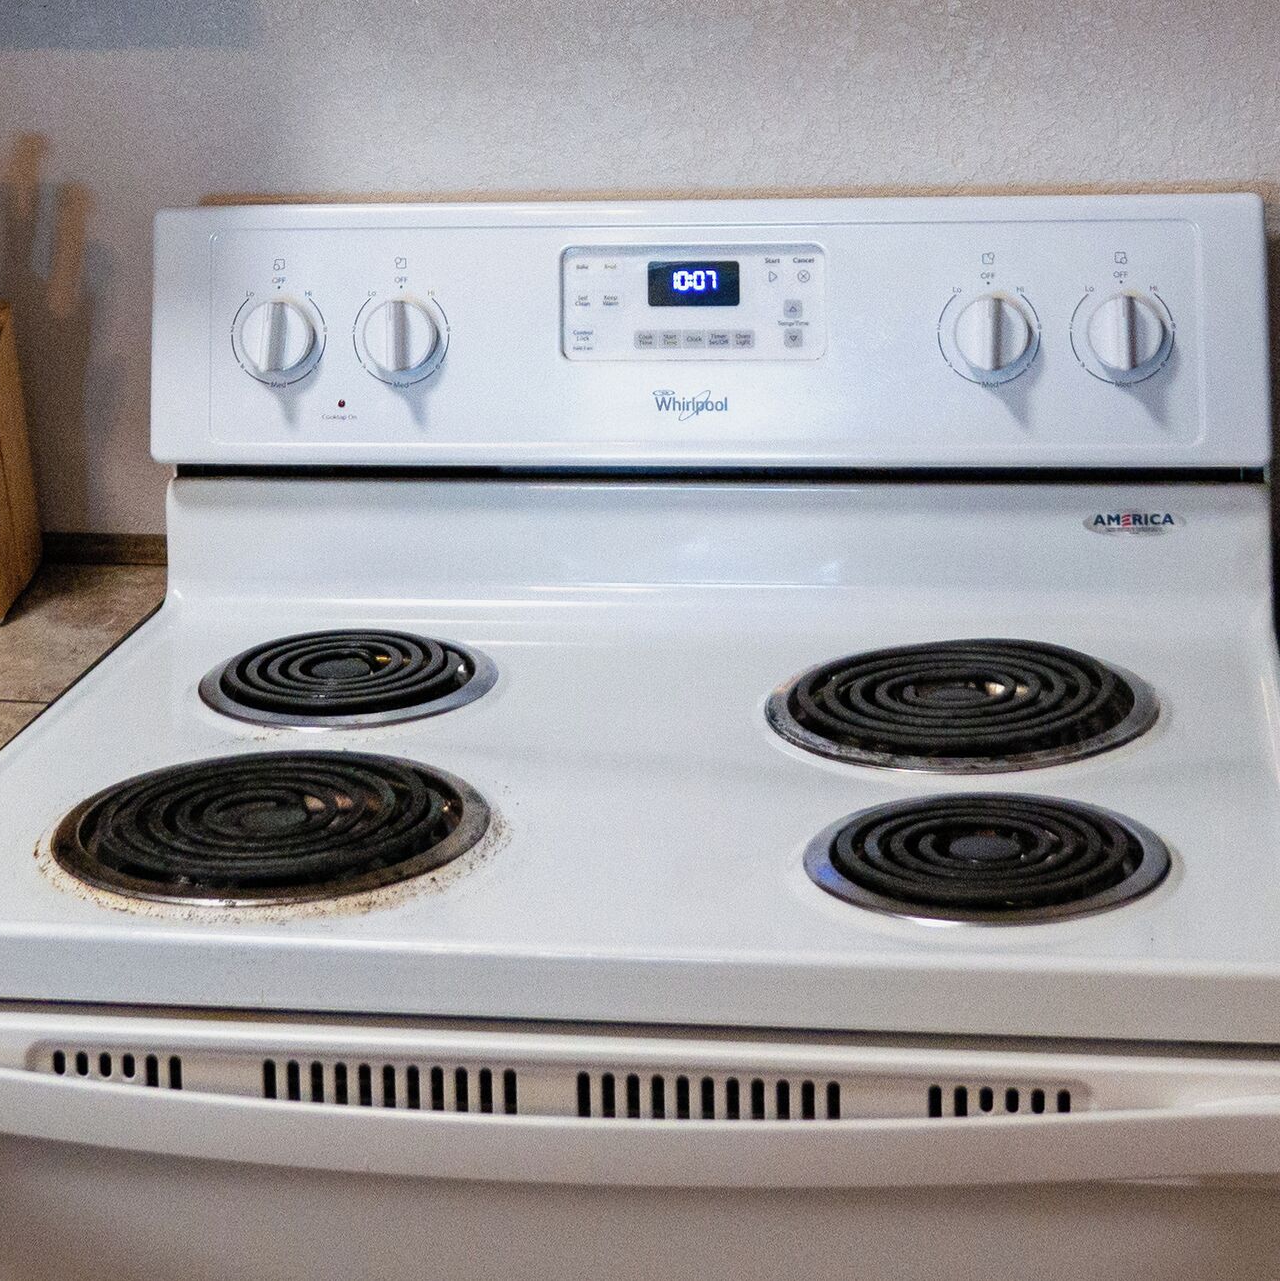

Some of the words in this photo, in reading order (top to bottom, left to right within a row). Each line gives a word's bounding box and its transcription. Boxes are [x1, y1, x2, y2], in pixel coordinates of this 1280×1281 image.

[980, 272, 995, 280] OFF
[1113, 271, 1128, 279] OFF
[394, 276, 408, 284] OFF
[672, 270, 718, 291] 10:07
[270, 381, 287, 389] Med
[393, 381, 410, 389] Med
[981, 380, 999, 388] Med
[1115, 380, 1132, 388] Med
[654, 396, 729, 417] Whirlpool
[1093, 513, 1175, 528] AMERICA
